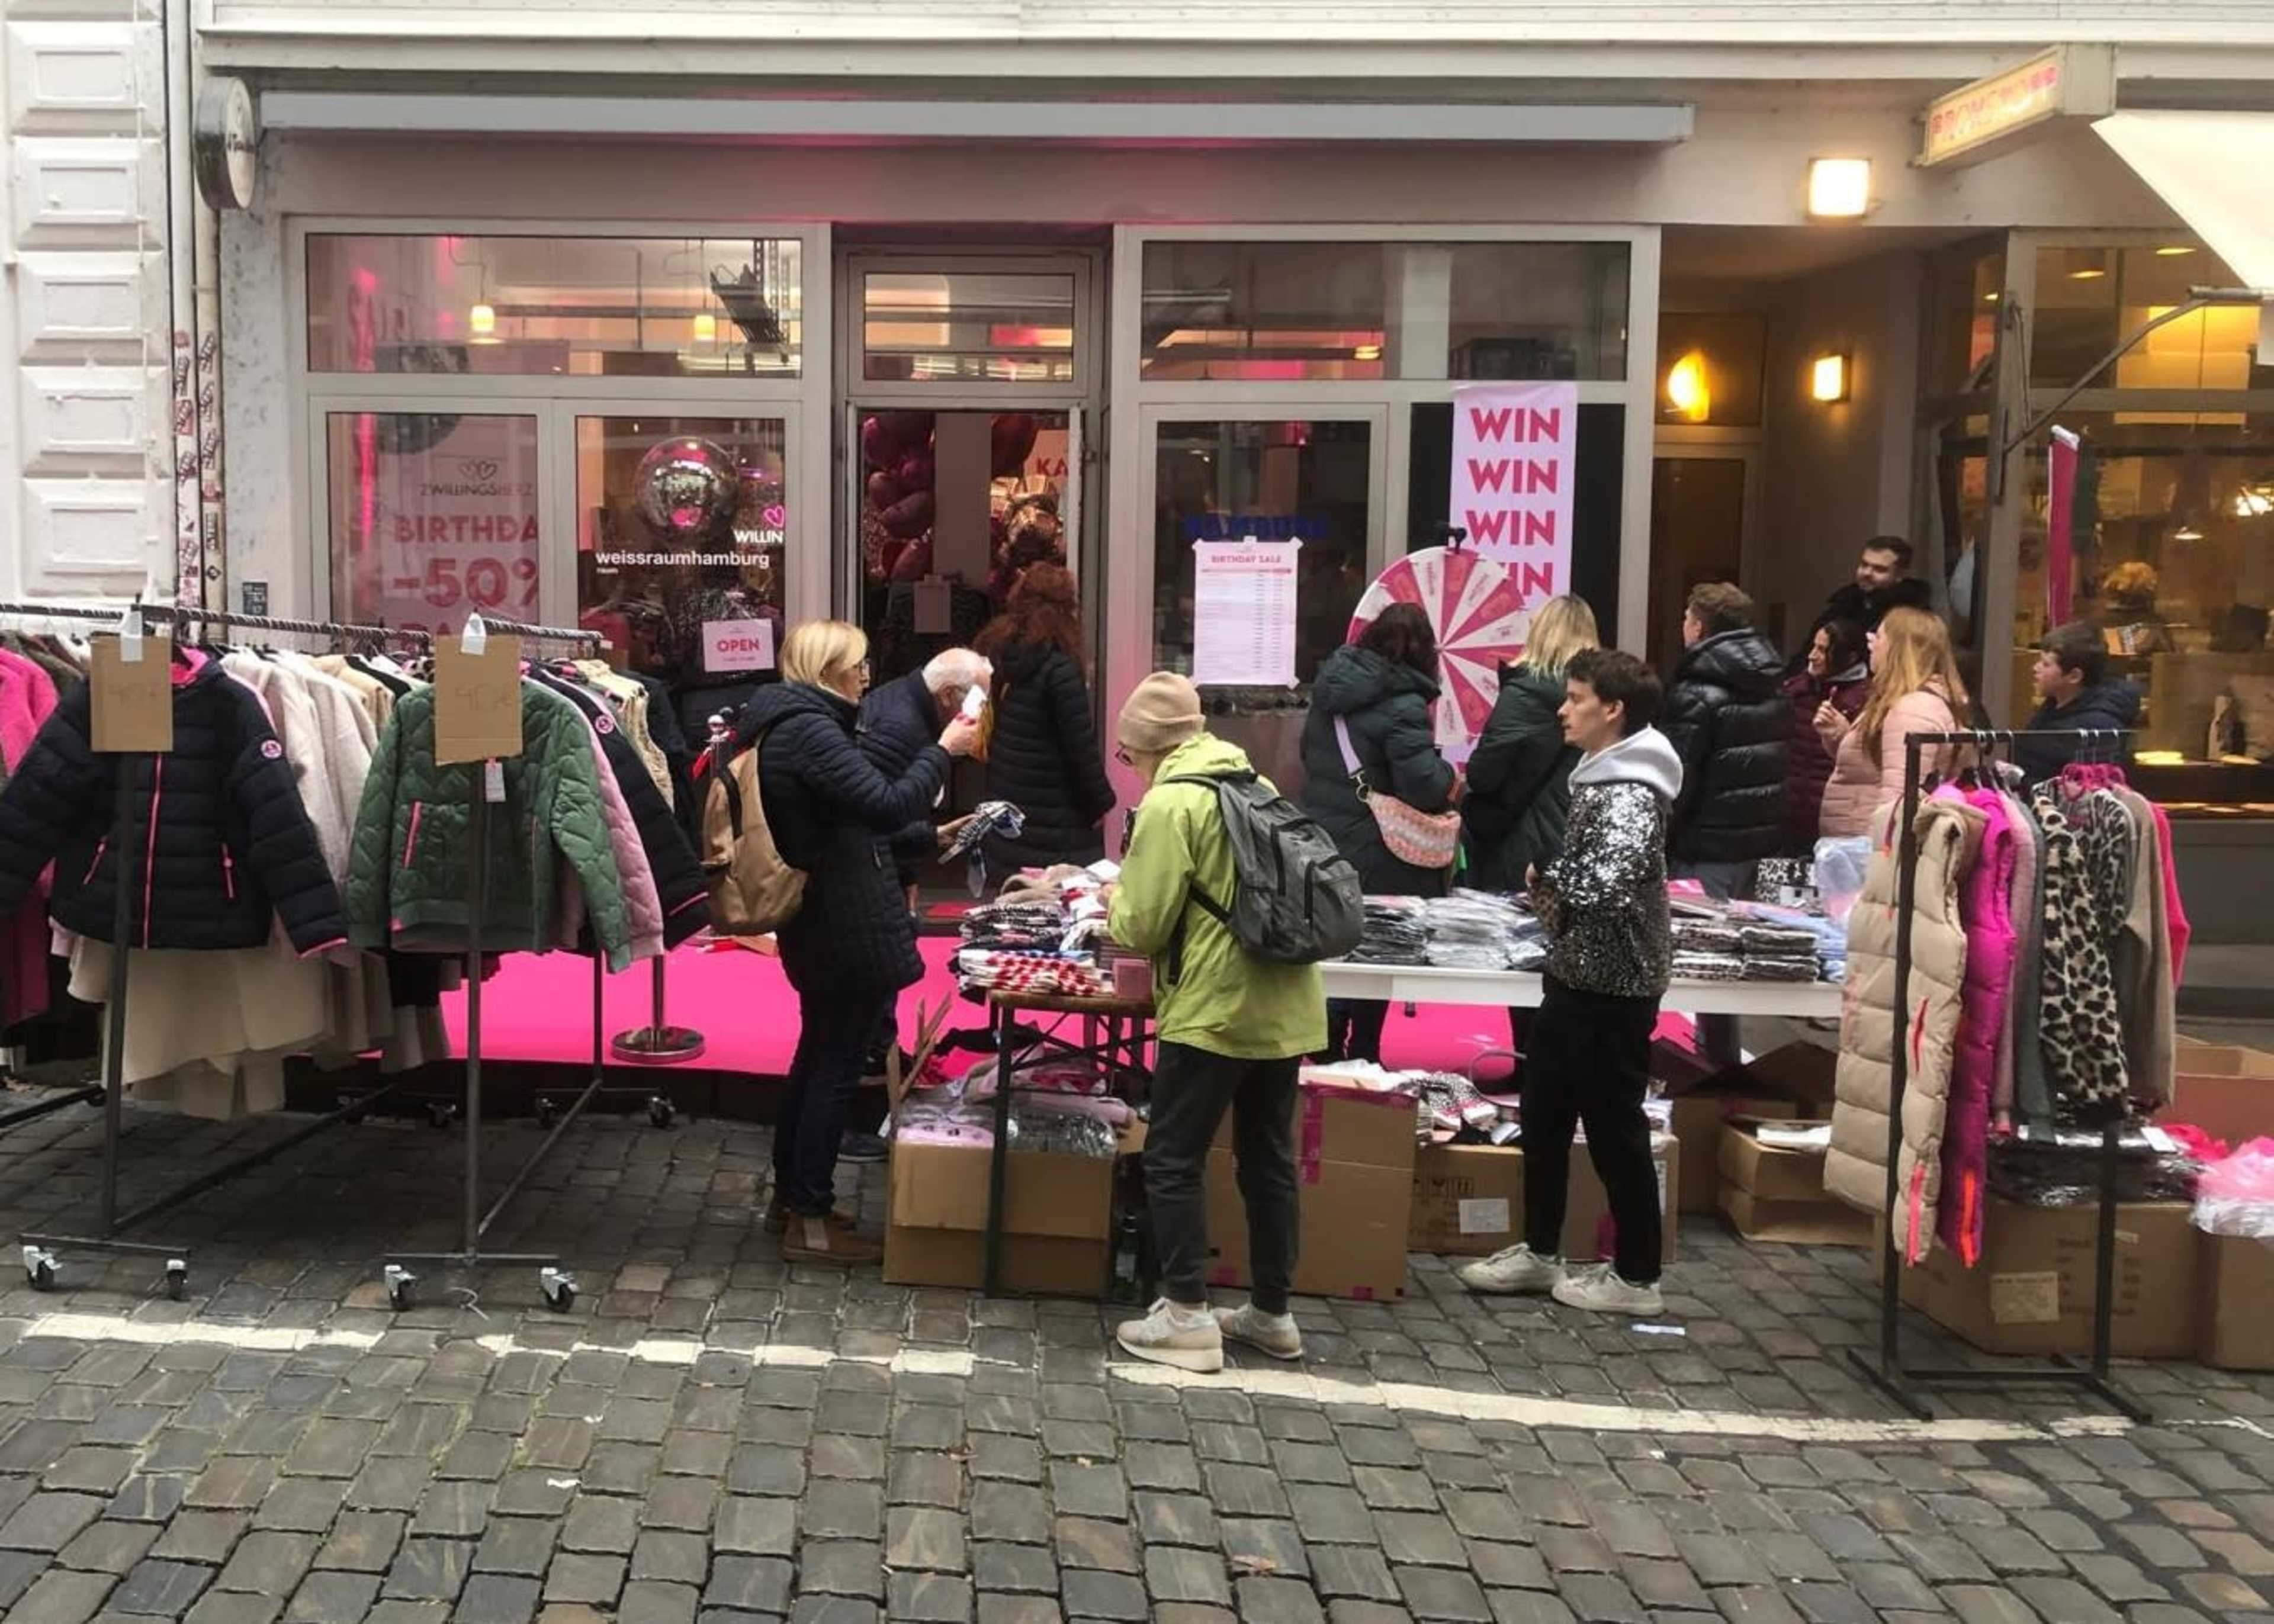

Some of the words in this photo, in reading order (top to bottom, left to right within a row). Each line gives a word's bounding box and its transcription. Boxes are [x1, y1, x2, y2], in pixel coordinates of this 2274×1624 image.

[1470, 408, 1560, 443] WIN
[1468, 459, 1557, 494] WIN
[1466, 510, 1555, 546] WIN
[596, 550, 769, 569] weissraumhamburg
[1212, 555, 1256, 563] BIRTHDAY
[1498, 562, 1553, 596] IN
[717, 638, 760, 652] OPEN
